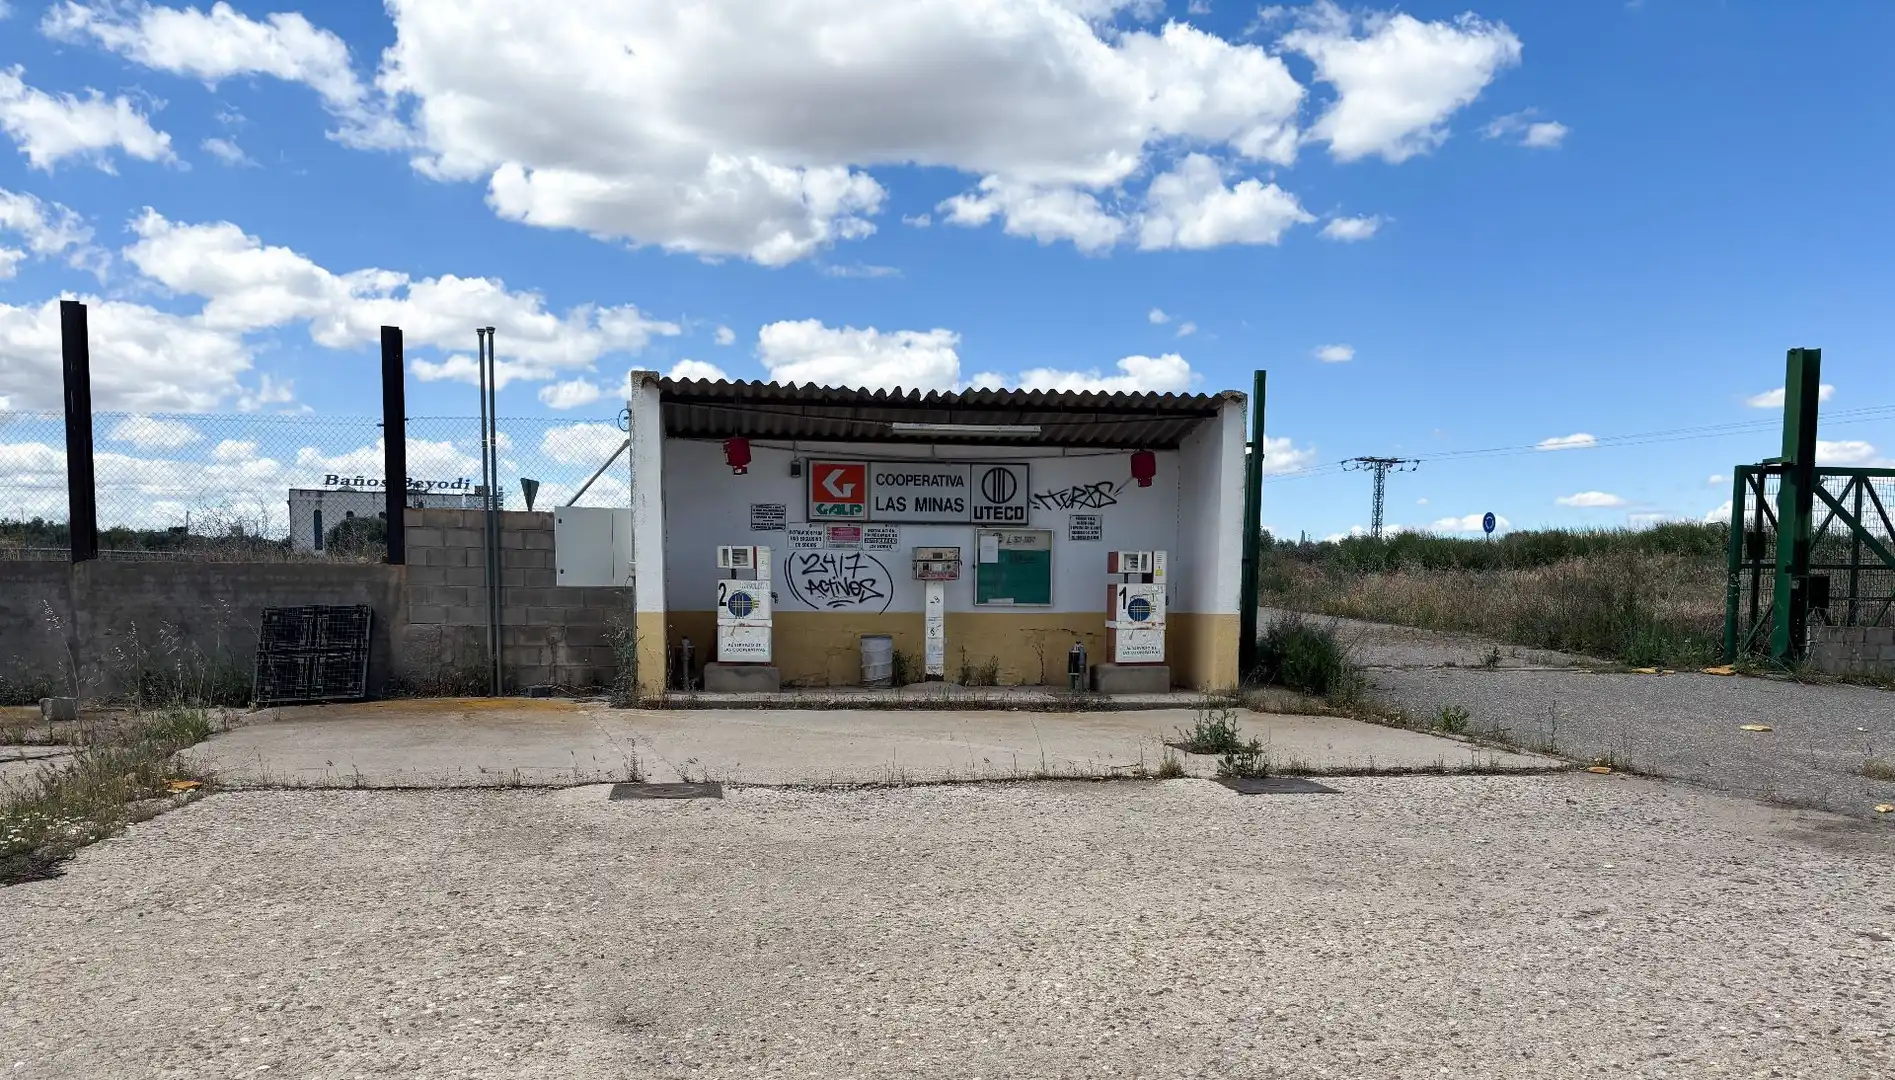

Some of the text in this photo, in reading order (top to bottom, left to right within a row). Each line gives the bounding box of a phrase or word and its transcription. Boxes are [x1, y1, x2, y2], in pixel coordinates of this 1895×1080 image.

[875, 473, 965, 487] COOPERATIVA
[815, 503, 863, 516] GALP
[875, 496, 965, 513] LAS MINAS
[799, 553, 869, 579] 24/7
[718, 582, 727, 607] 2
[1119, 586, 1127, 610] 1
